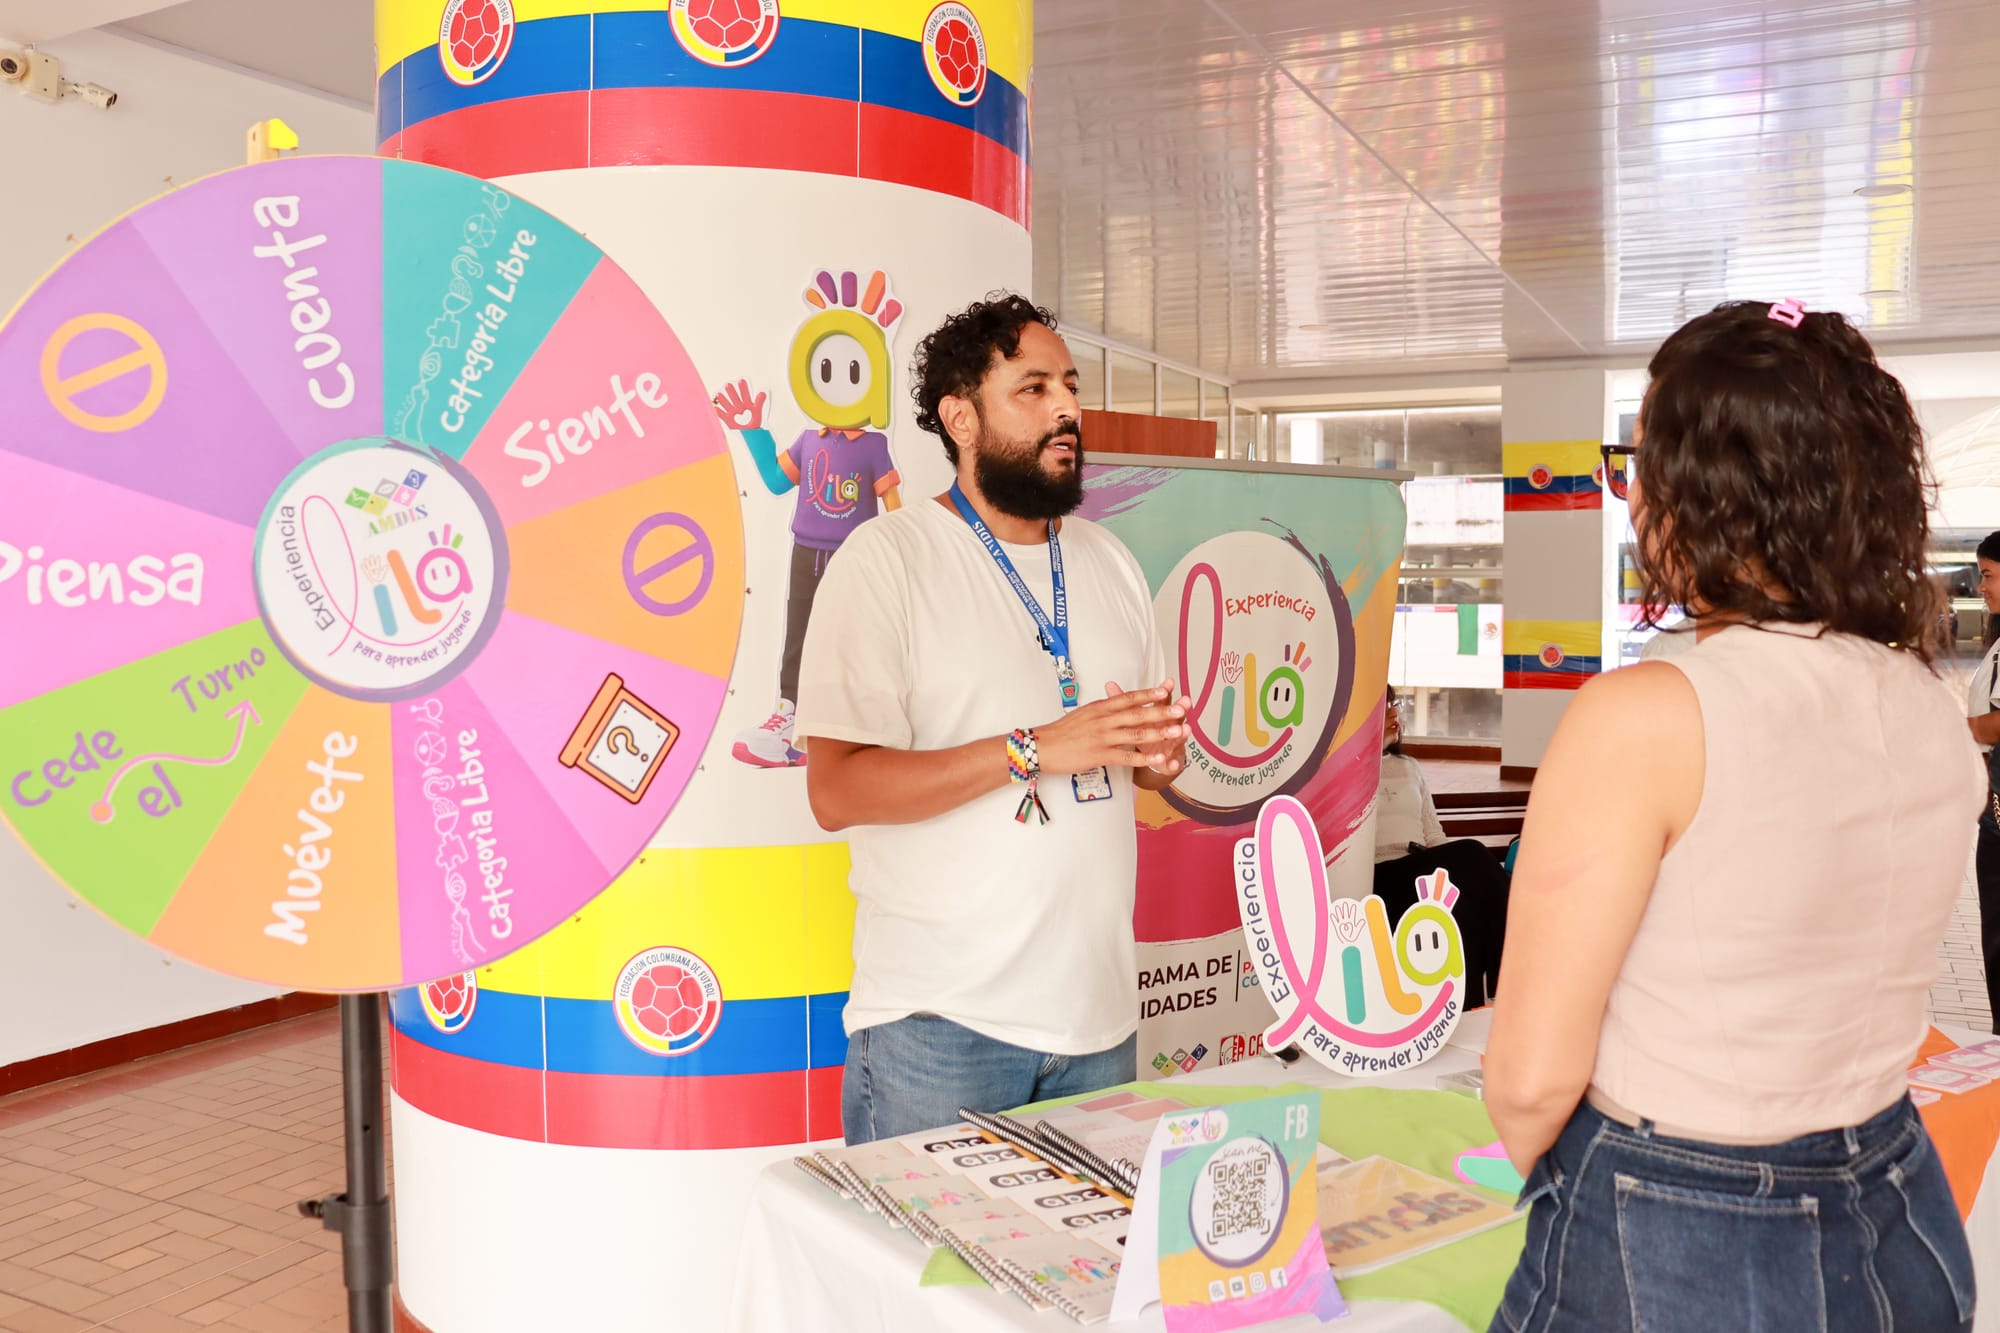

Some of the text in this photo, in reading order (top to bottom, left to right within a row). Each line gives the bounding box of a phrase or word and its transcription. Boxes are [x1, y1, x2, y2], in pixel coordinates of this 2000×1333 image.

[442, 0, 460, 36] FEDERACIO
[486, 229, 537, 303] Libre
[504, 372, 668, 487] Siente
[367, 503, 429, 537] AMDIS
[276, 505, 336, 631] Experiencia
[1055, 586, 1067, 628] AMDIS
[1225, 590, 1316, 622] Experiencia
[384, 647, 440, 669] aprender
[438, 609, 472, 656] jugando
[137, 762, 182, 818] el
[170, 647, 266, 713] Turno
[457, 728, 489, 806] Libre
[1208, 766, 1256, 786] aprender
[1258, 743, 1293, 785] jugando
[264, 731, 364, 945] Muévete
[1238, 843, 1290, 1003] Experiencia
[646, 952, 691, 967] COLOMBIANA
[689, 962, 701, 973] DE
[1206, 955, 1233, 977] DE
[1342, 1047, 1411, 1072] aprender
[1413, 1001, 1457, 1062] jugando
[1284, 1104, 1309, 1141] FB
[960, 1148, 1017, 1168] abc
[996, 1168, 1054, 1188] abc
[1042, 1188, 1101, 1208] abc
[1069, 1207, 1131, 1228] abc
